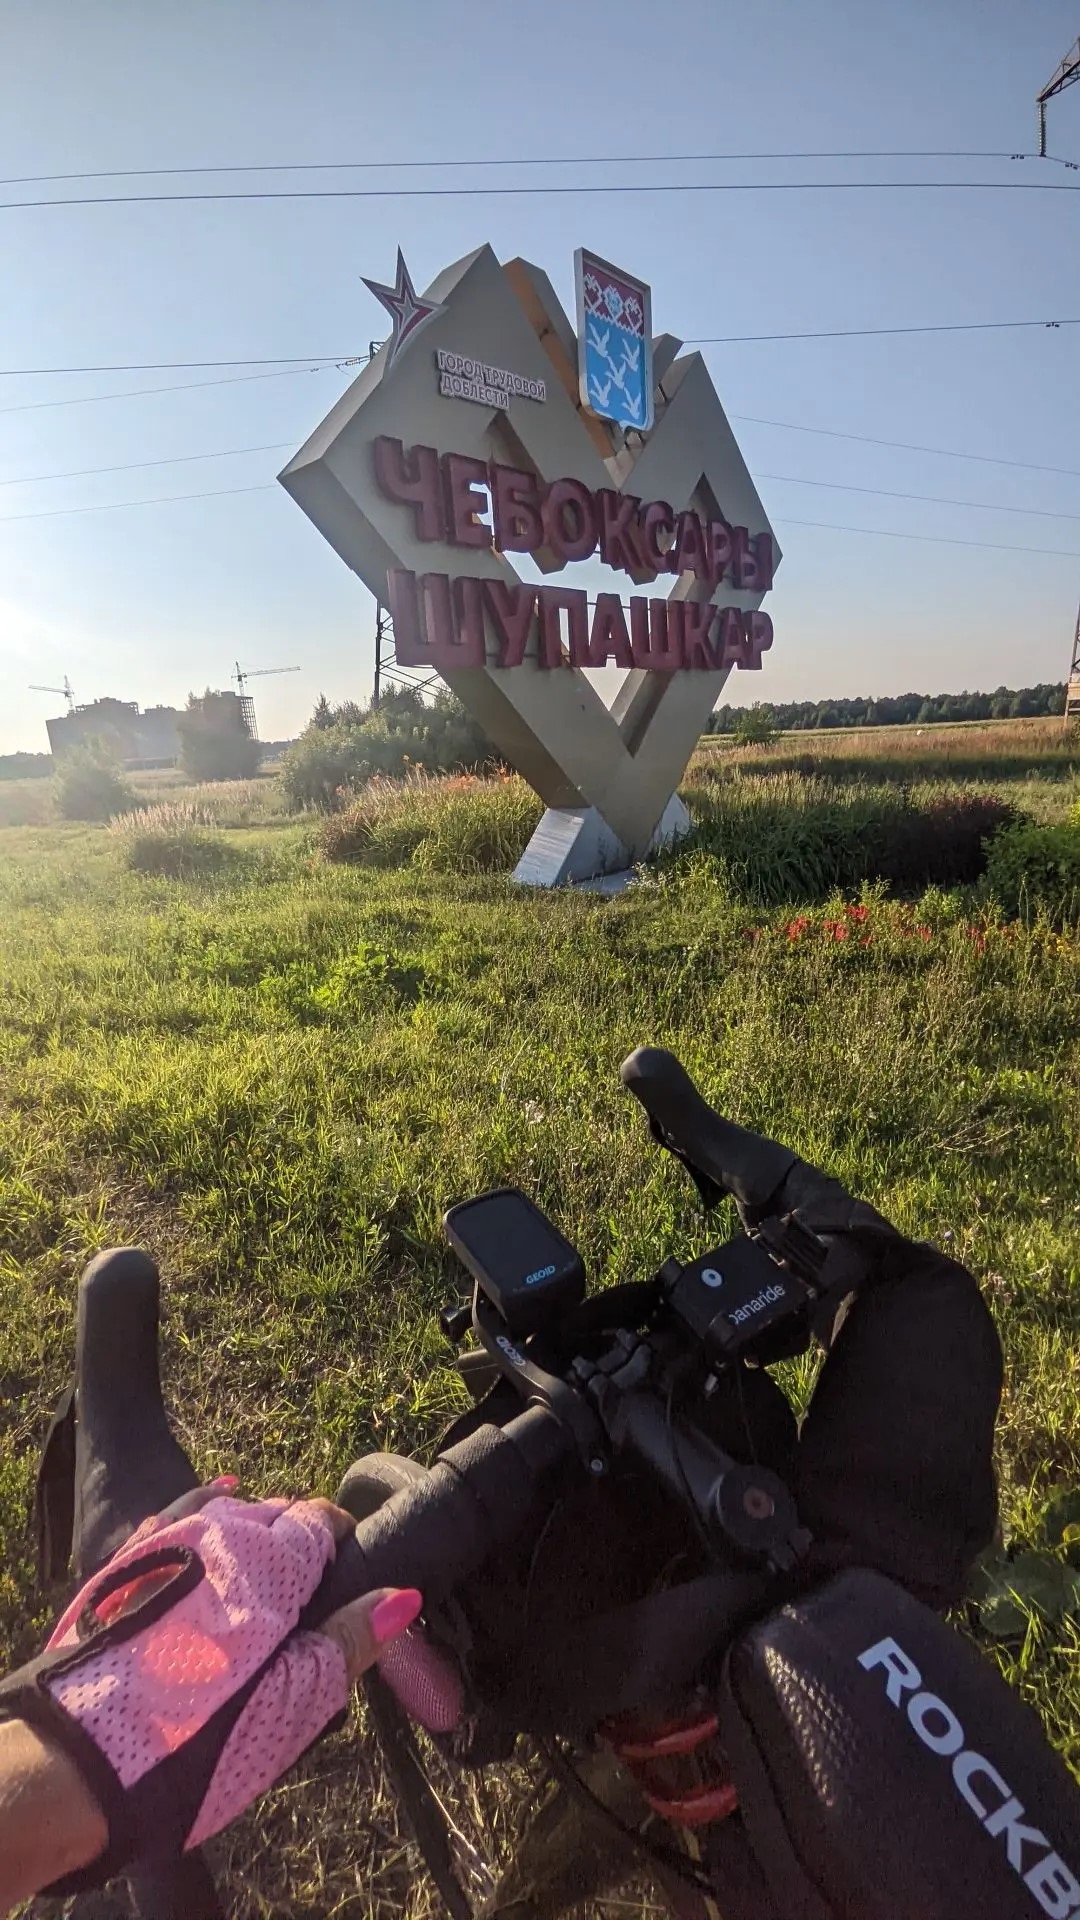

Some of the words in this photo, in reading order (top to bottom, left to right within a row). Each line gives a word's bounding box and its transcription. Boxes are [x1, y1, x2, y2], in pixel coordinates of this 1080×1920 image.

[438, 350, 484, 381] ГОРОД
[483, 366, 546, 399] ТРУДОВОЙ
[441, 372, 508, 408] ДОБЛЕСТИ
[373, 435, 772, 591] ЧЕБОКСАРЫ
[387, 568, 773, 670] ШУПАШКАР
[526, 1265, 556, 1284] GEOID
[857, 1637, 1080, 1920] ROCKB
